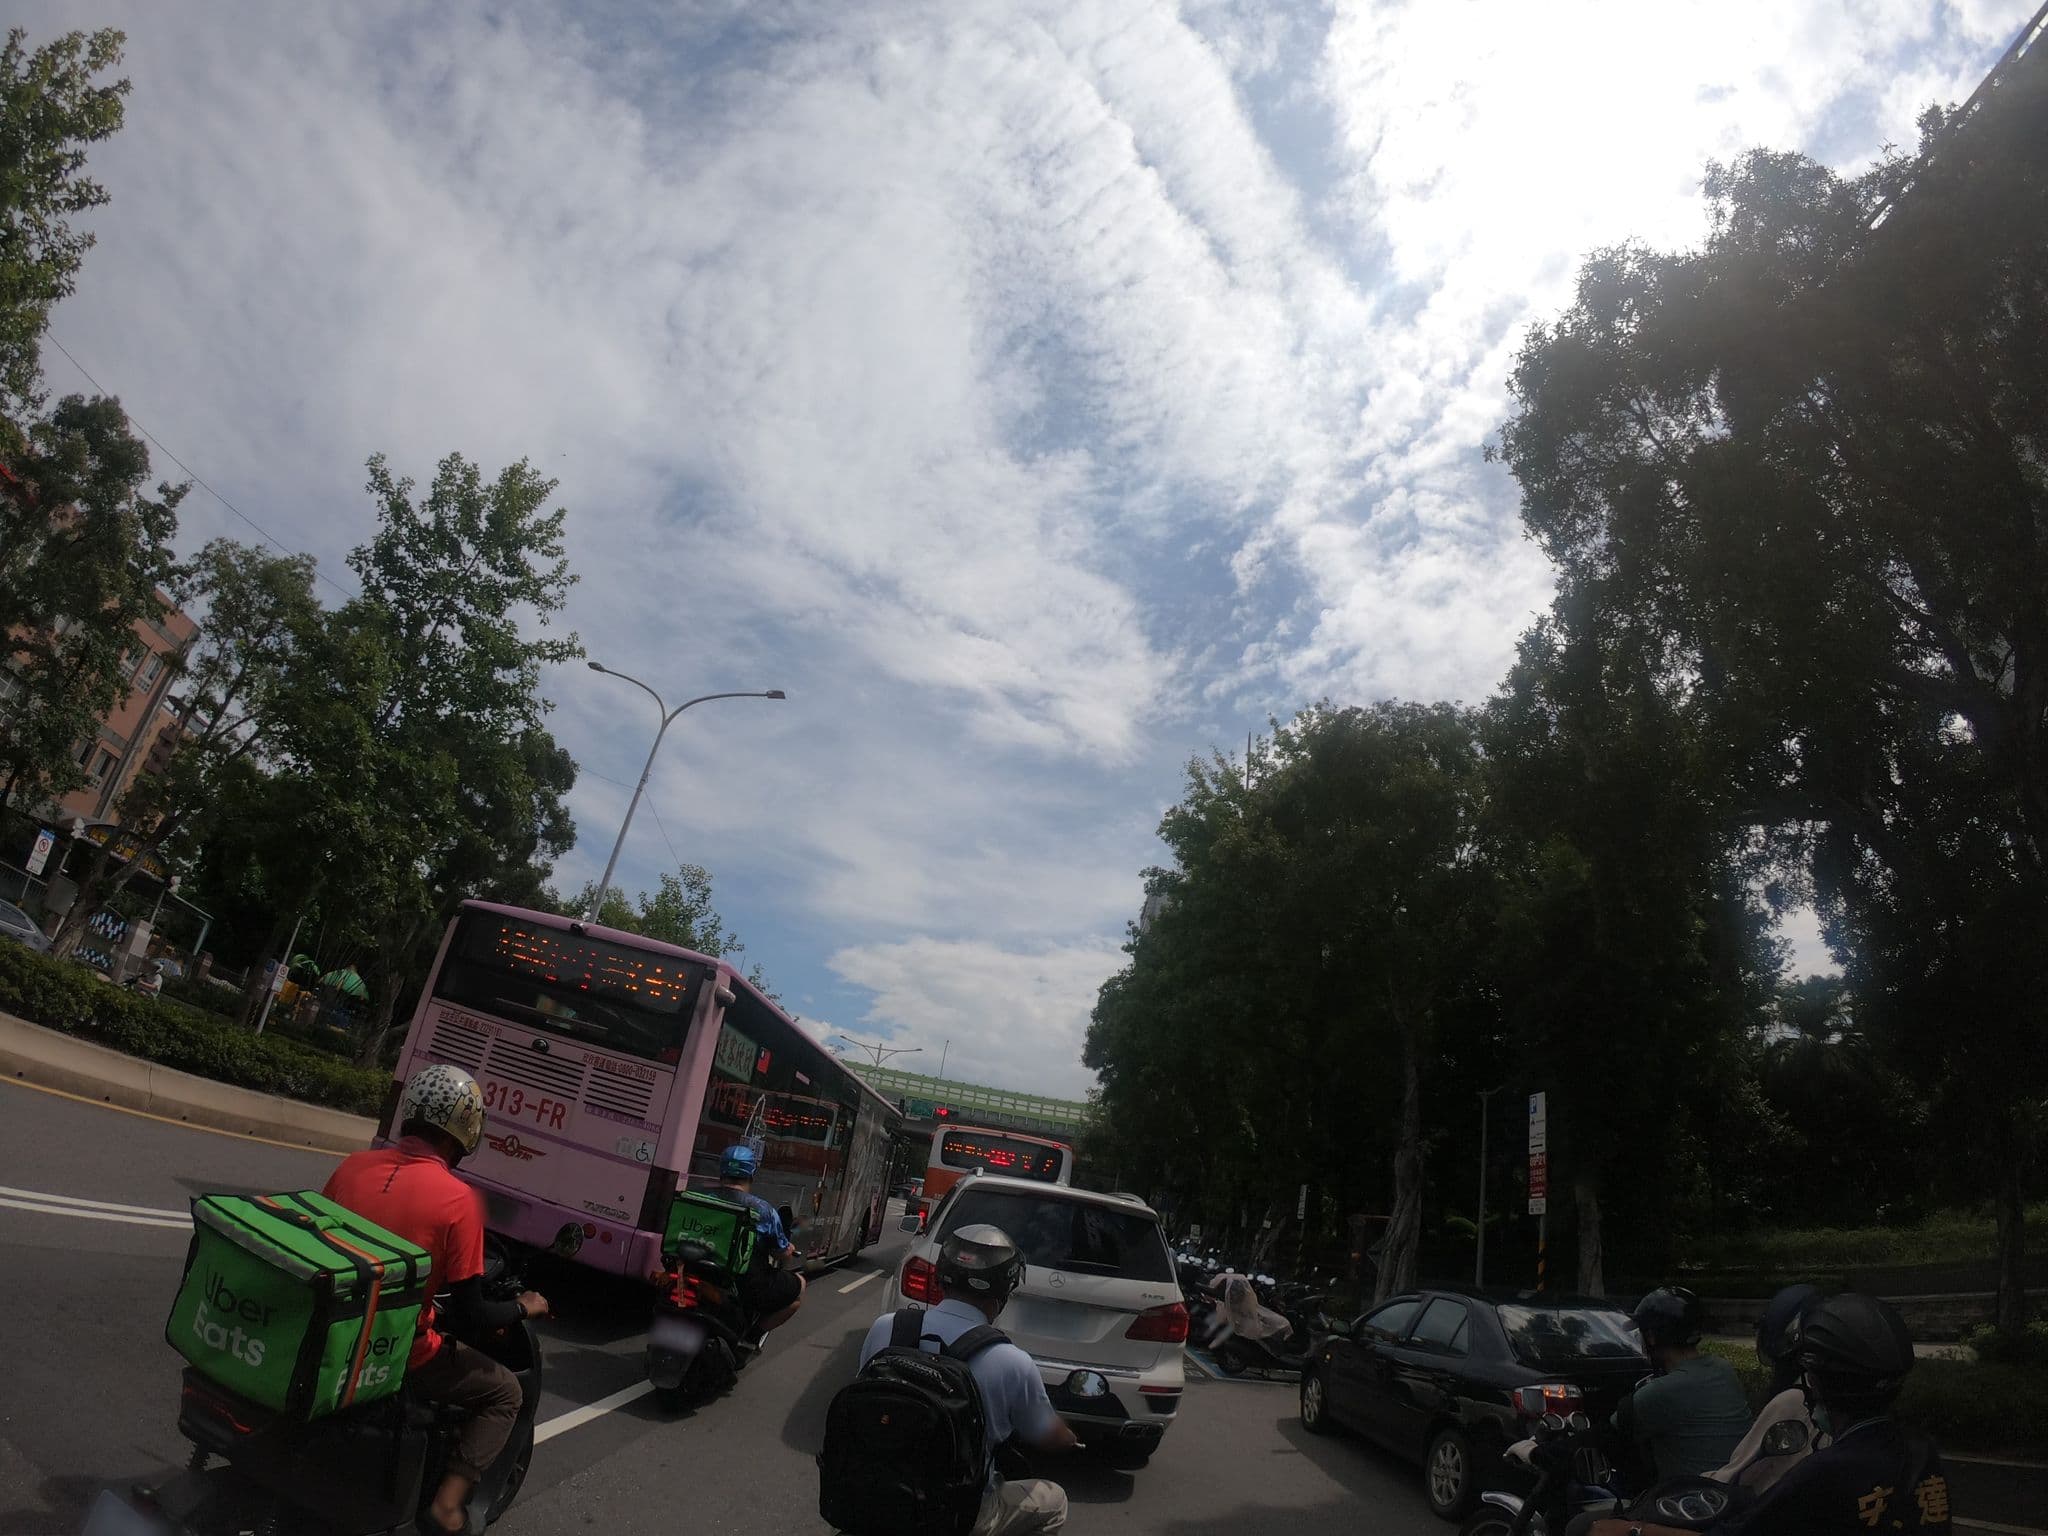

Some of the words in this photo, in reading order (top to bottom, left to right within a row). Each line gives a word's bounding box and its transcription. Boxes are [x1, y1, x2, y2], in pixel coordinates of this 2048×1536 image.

[483, 1081, 567, 1130] 313-FR
[682, 1216, 720, 1236] Uber
[204, 1264, 277, 1326] Uber
[192, 1300, 266, 1367] Eats
